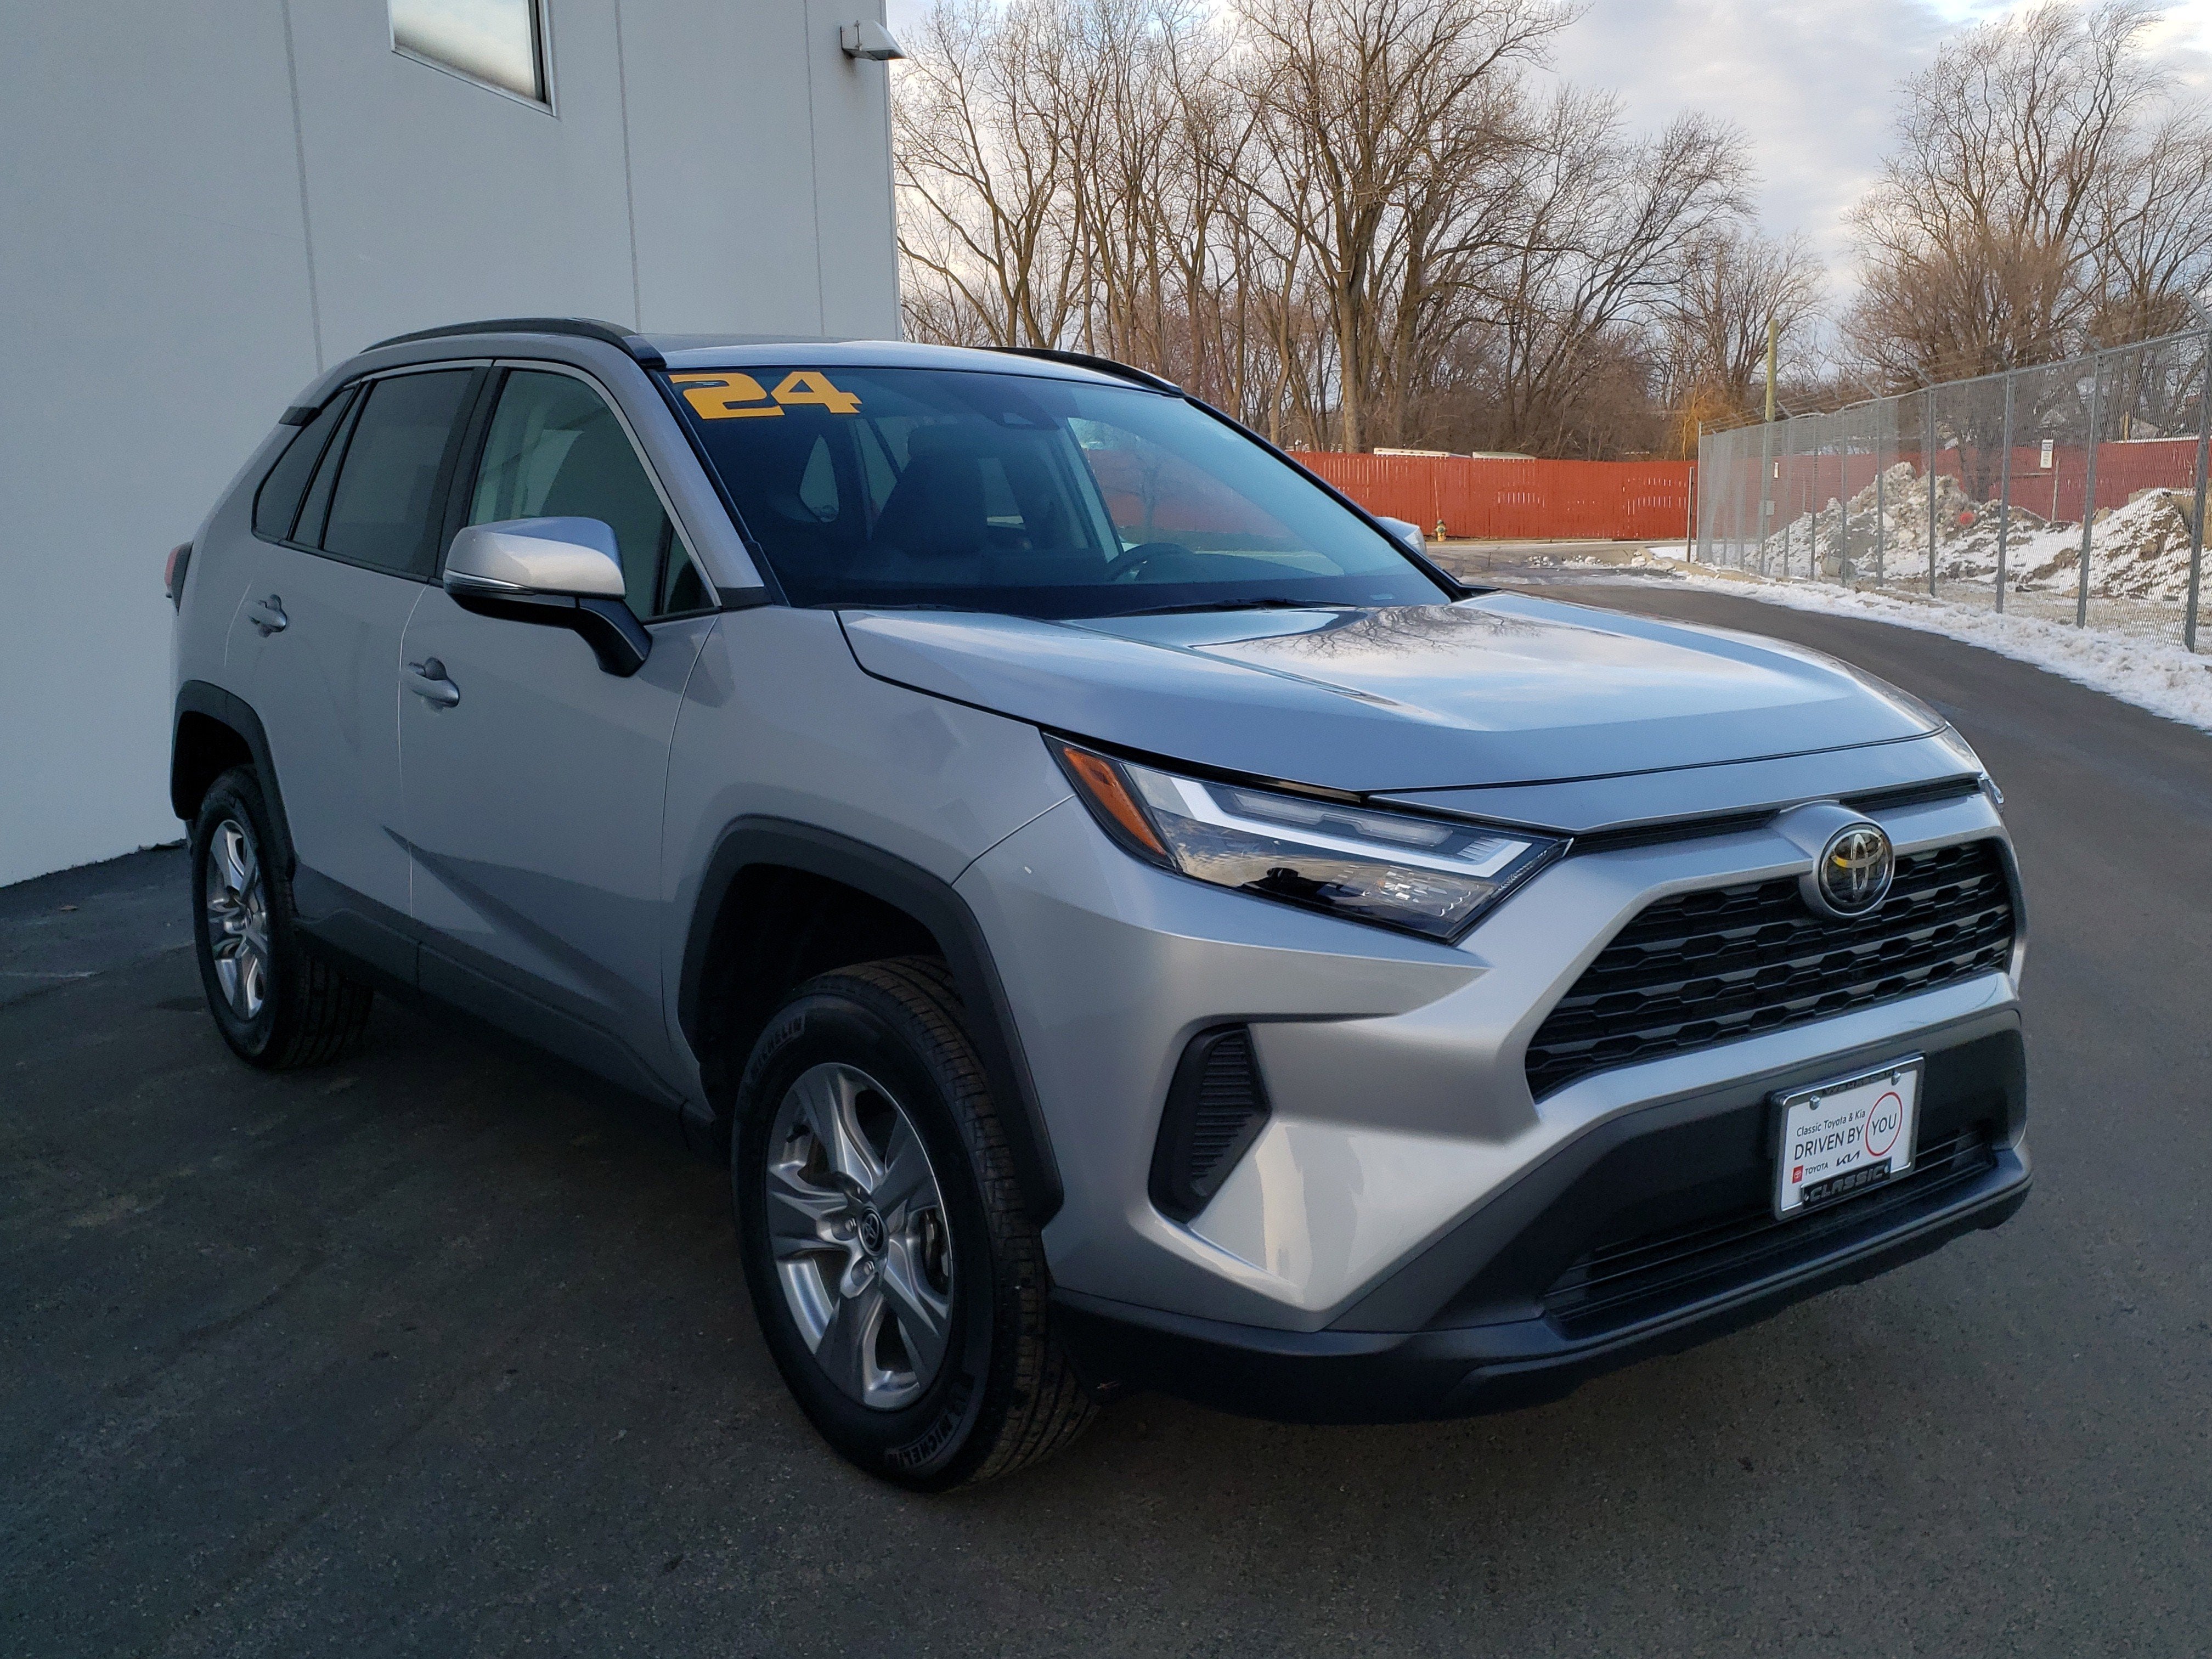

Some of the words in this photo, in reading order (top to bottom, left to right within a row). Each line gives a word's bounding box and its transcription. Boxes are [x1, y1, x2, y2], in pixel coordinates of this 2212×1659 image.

[668, 371, 862, 420] 24
[1795, 1131, 1844, 1160] DRIVEN
[1847, 1124, 1864, 1144] BY
[1872, 1113, 1898, 1136] YOU
[1796, 1122, 1821, 1137] Classic
[1824, 1115, 1846, 1130] Toyota
[1848, 1112, 1853, 1122] &
[1855, 1109, 1865, 1120] Kia
[1805, 1162, 1829, 1176] TOYOTA
[1810, 1164, 1886, 1202] CLASSIC
